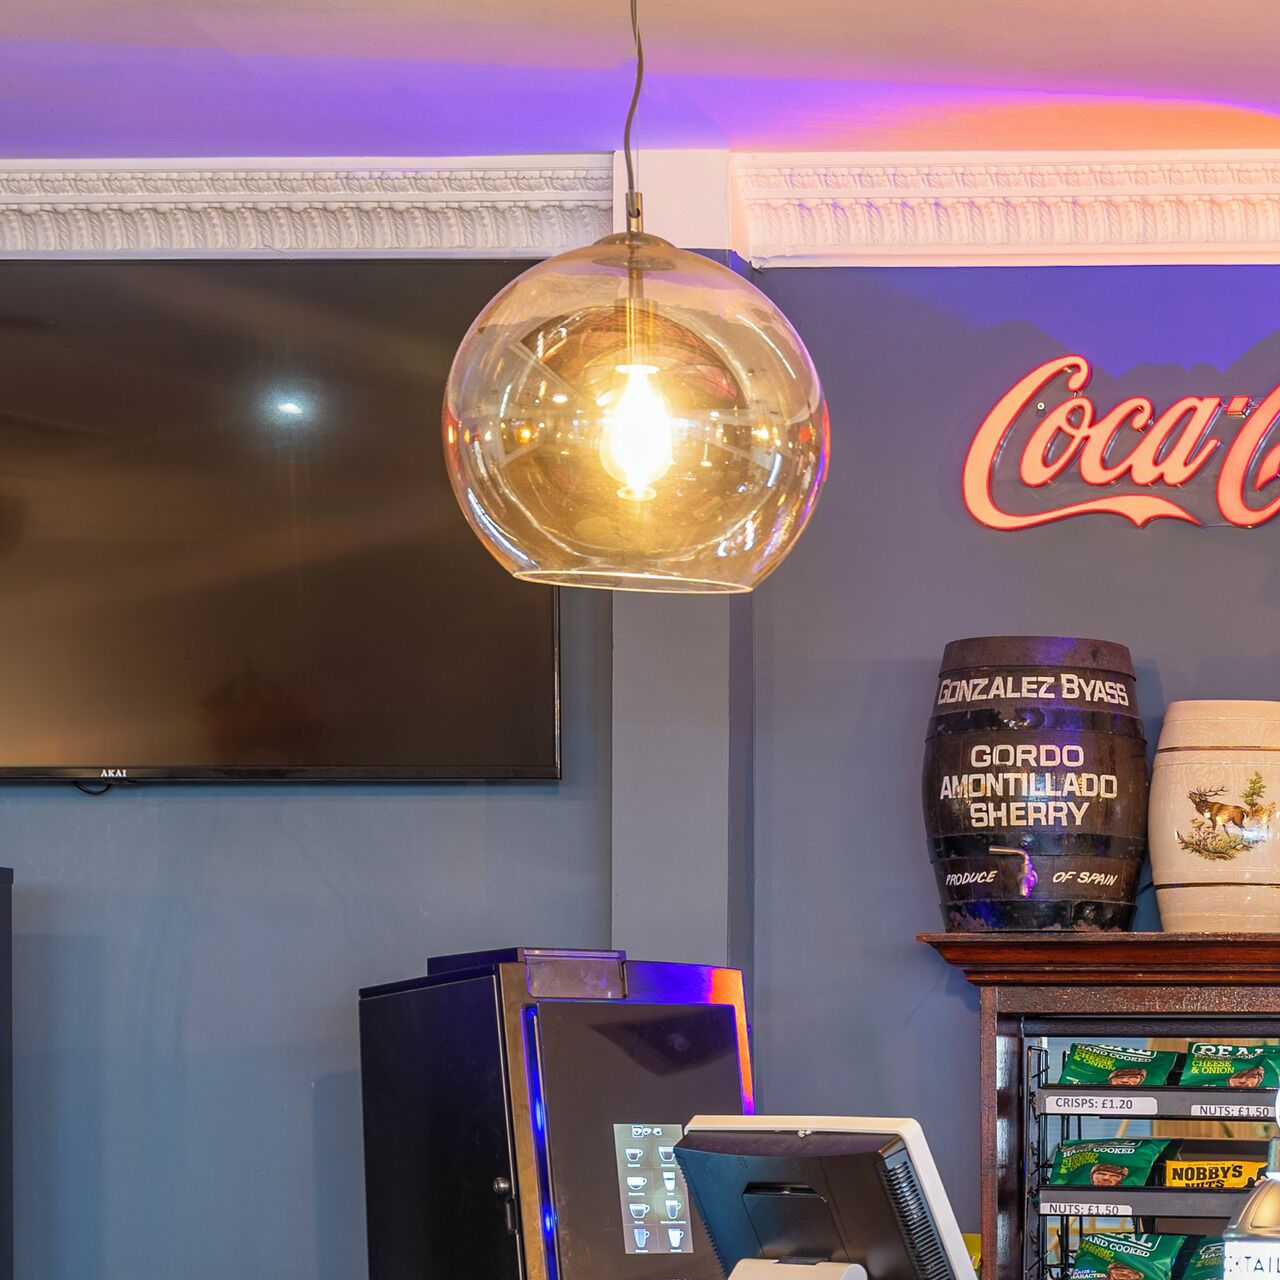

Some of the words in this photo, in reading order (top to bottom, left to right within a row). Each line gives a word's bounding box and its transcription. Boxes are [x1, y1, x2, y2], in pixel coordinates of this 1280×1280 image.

[937, 674, 1055, 706] GONZALEZ
[1060, 674, 1129, 706] BYASS
[970, 744, 1084, 768] GORDO
[101, 769, 127, 777] AKAI
[940, 773, 1118, 799] AMONTILLADO
[969, 801, 1089, 828] SHERRY
[945, 870, 997, 886] PRODUCE
[1052, 870, 1072, 885] OF
[1075, 871, 1118, 887] SPAIN
[1109, 1050, 1152, 1063] COOKED
[1191, 1060, 1232, 1068] CHEESE
[1201, 1066, 1235, 1074] ONION
[1055, 1097, 1098, 1109] CRISPS:
[1101, 1099, 1133, 1110] £1.20
[1200, 1105, 1234, 1117] NUTS:
[1238, 1107, 1269, 1117] £1.50
[1172, 1163, 1243, 1181] NOBBY'S
[1050, 1204, 1084, 1215] NUTS:
[1087, 1205, 1119, 1215] £1.50
[1082, 1236, 1107, 1248] AND
[1110, 1242, 1150, 1257] COOKED
